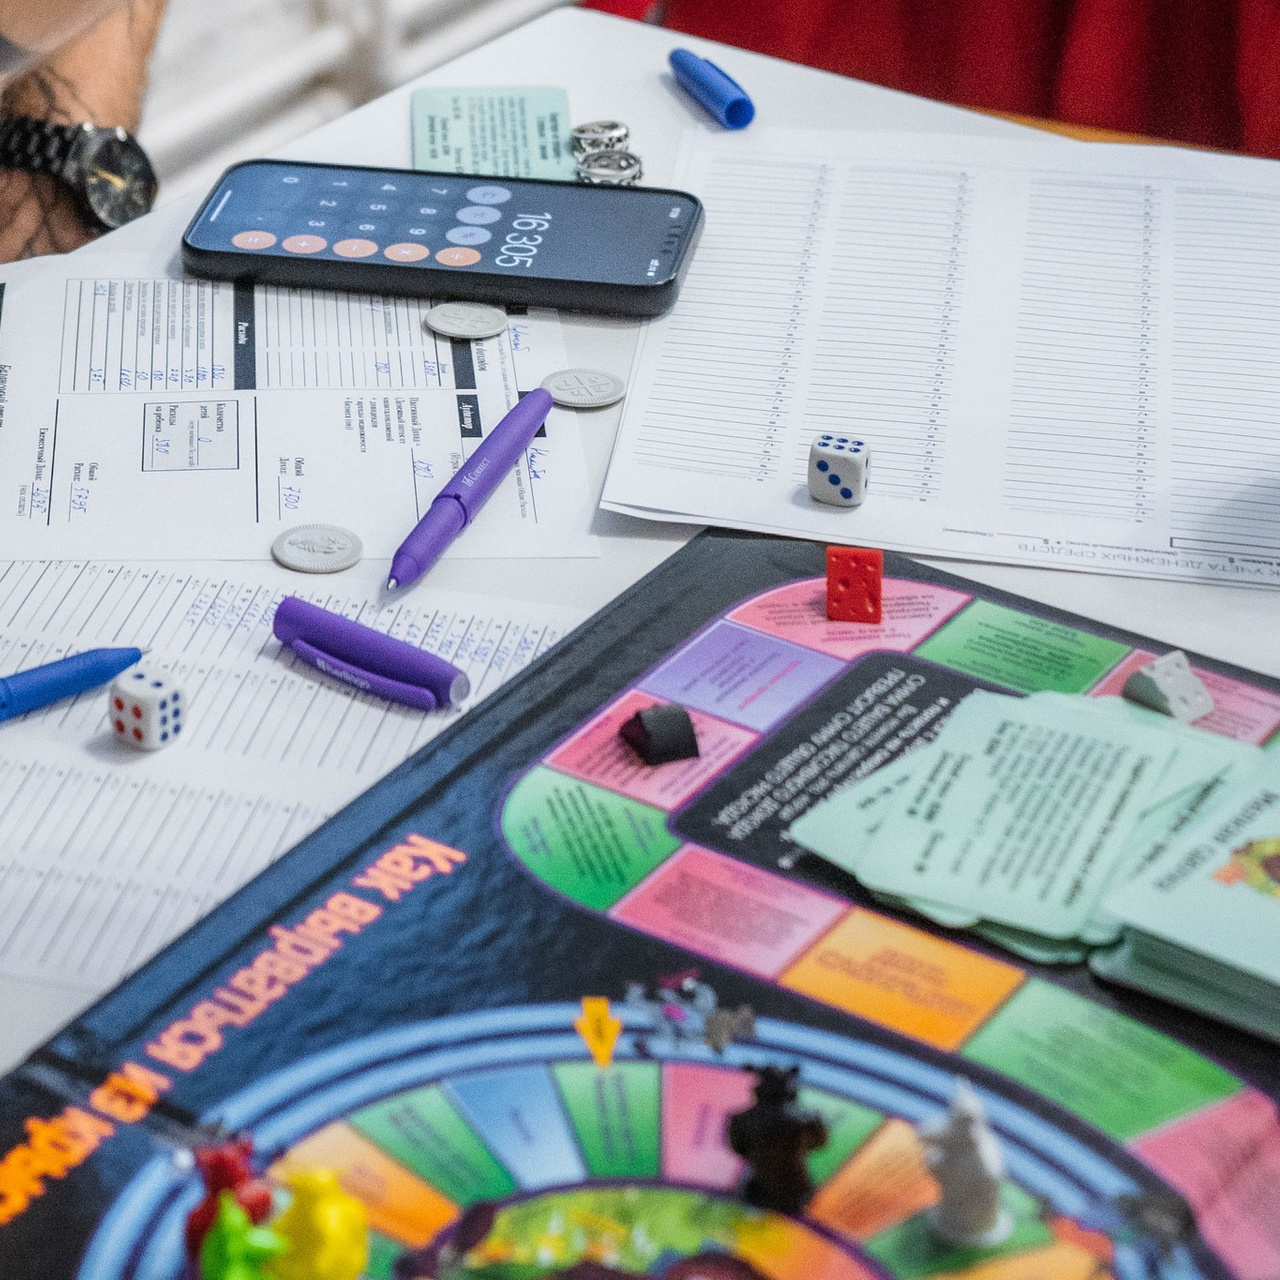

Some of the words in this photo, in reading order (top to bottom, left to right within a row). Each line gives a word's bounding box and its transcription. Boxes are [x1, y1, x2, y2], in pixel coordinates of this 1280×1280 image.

[238, 322, 247, 344] Расходы
[136, 371, 147, 381] 50
[168, 405, 178, 426] Расходы
[199, 405, 209, 418] детей
[215, 403, 225, 432] Количество
[393, 397, 405, 424] (Денежный
[409, 398, 421, 424] Пассивный
[153, 412, 164, 432] ребенка
[36, 428, 48, 462] Ежемесячный
[409, 426, 421, 442] Доход
[33, 464, 45, 481] Доход:
[73, 462, 83, 482] Расход:
[88, 462, 97, 481] Общий
[278, 457, 289, 474] Доход:
[293, 457, 304, 476] Общий
[17, 485, 27, 494] (чек
[282, 486, 302, 509] 7500
[1017, 542, 1097, 561] СРЕДСТВ
[1100, 550, 1203, 572] ДЕНЕЖНЫХ
[1206, 561, 1264, 578] УЧЕТА
[841, 702, 890, 744] ВАШЕГО
[764, 742, 818, 783] ОБЩЕГО
[773, 740, 852, 803] ПАССИВНОГО
[728, 797, 780, 840] ДОХОДА
[352, 831, 469, 900] Как
[145, 889, 381, 1074] вырваться
[88, 1060, 172, 1124] из
